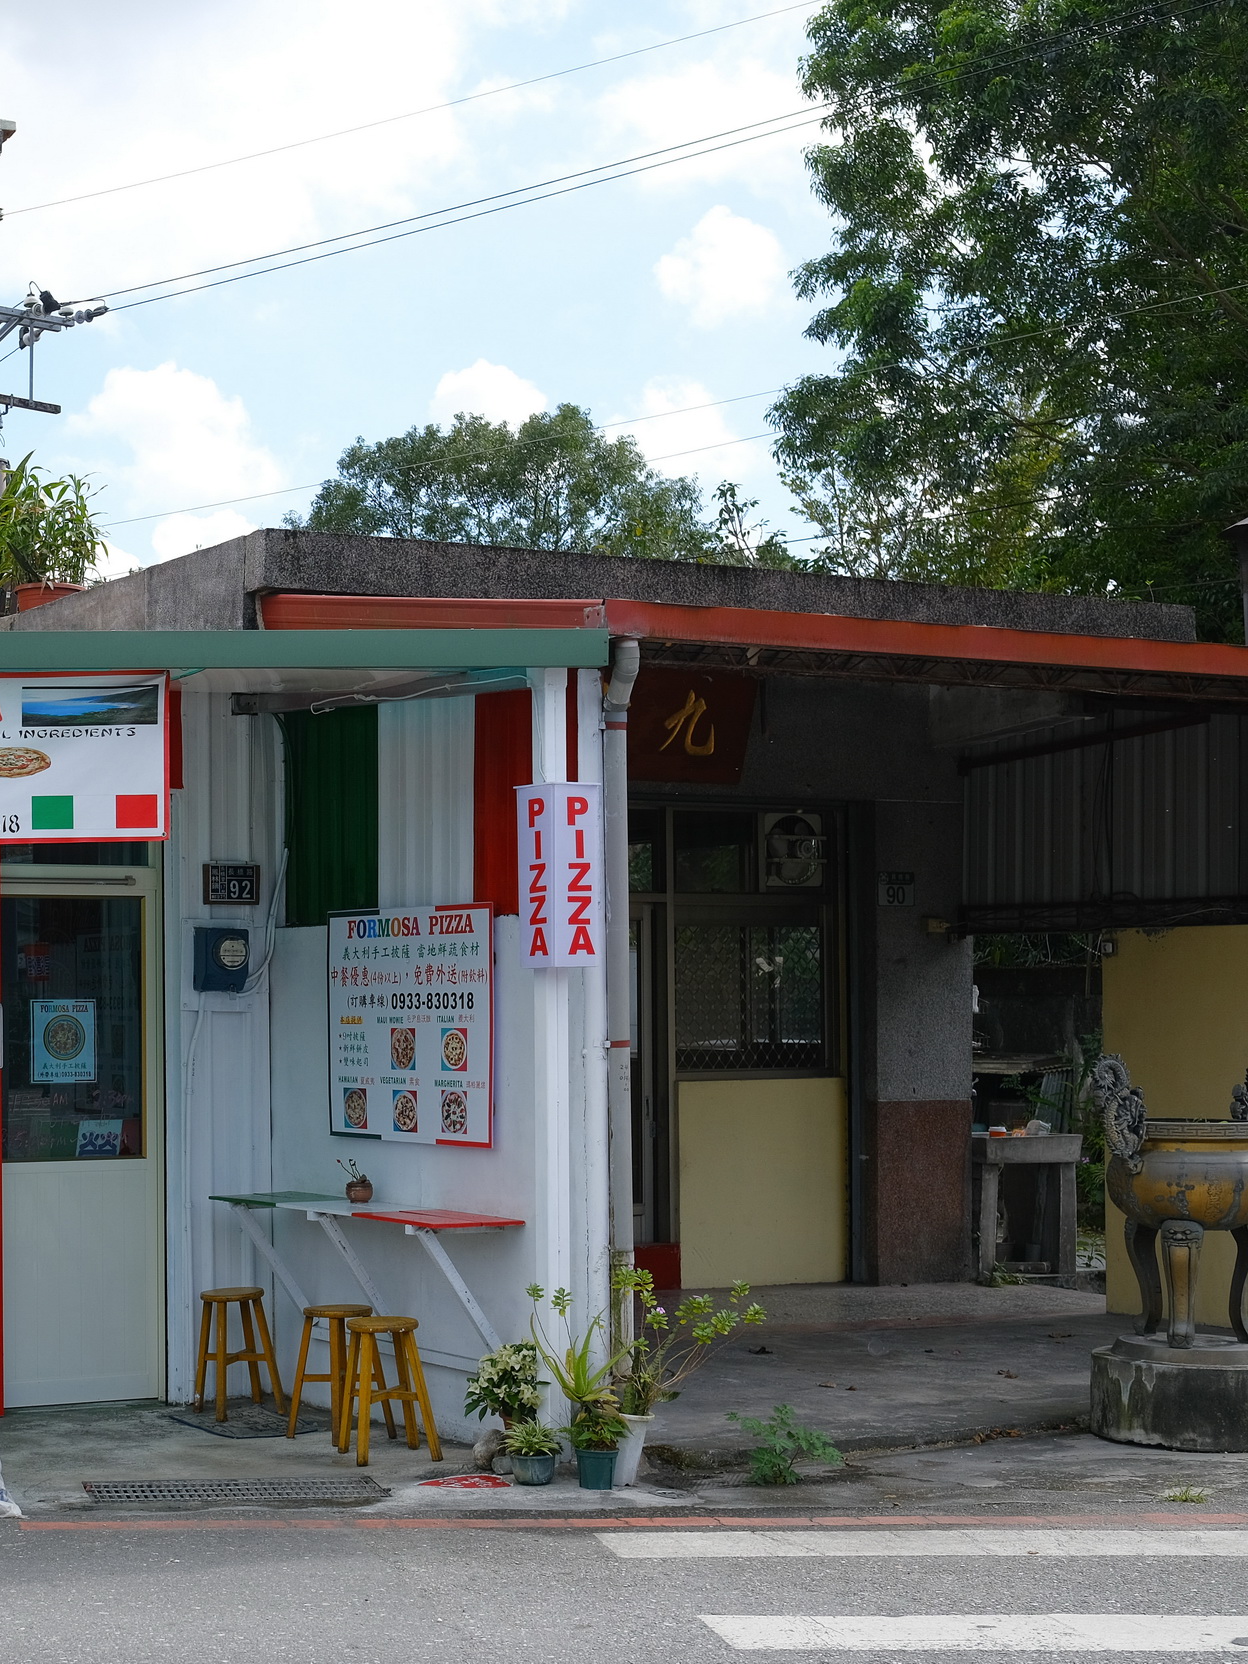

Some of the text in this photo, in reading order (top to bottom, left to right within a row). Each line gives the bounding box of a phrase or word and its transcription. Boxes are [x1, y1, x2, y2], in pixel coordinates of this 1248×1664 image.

[18, 727, 137, 738] INGREDIENTS
[528, 797, 549, 957] PIZZA
[566, 796, 596, 956] PIZZA
[230, 880, 251, 899] 92
[886, 886, 905, 905] 90
[347, 913, 474, 940] FORMOSA PIZZA
[342, 944, 411, 961] 義大利手工披薩
[40, 1004, 88, 1013] FORMOSA PIZZA
[391, 992, 474, 1010] 0933-830318
[436, 1015, 454, 1024] ITALIAN
[380, 1076, 406, 1085] VEGETARIAN
[434, 1079, 463, 1088] MARGHERITA
